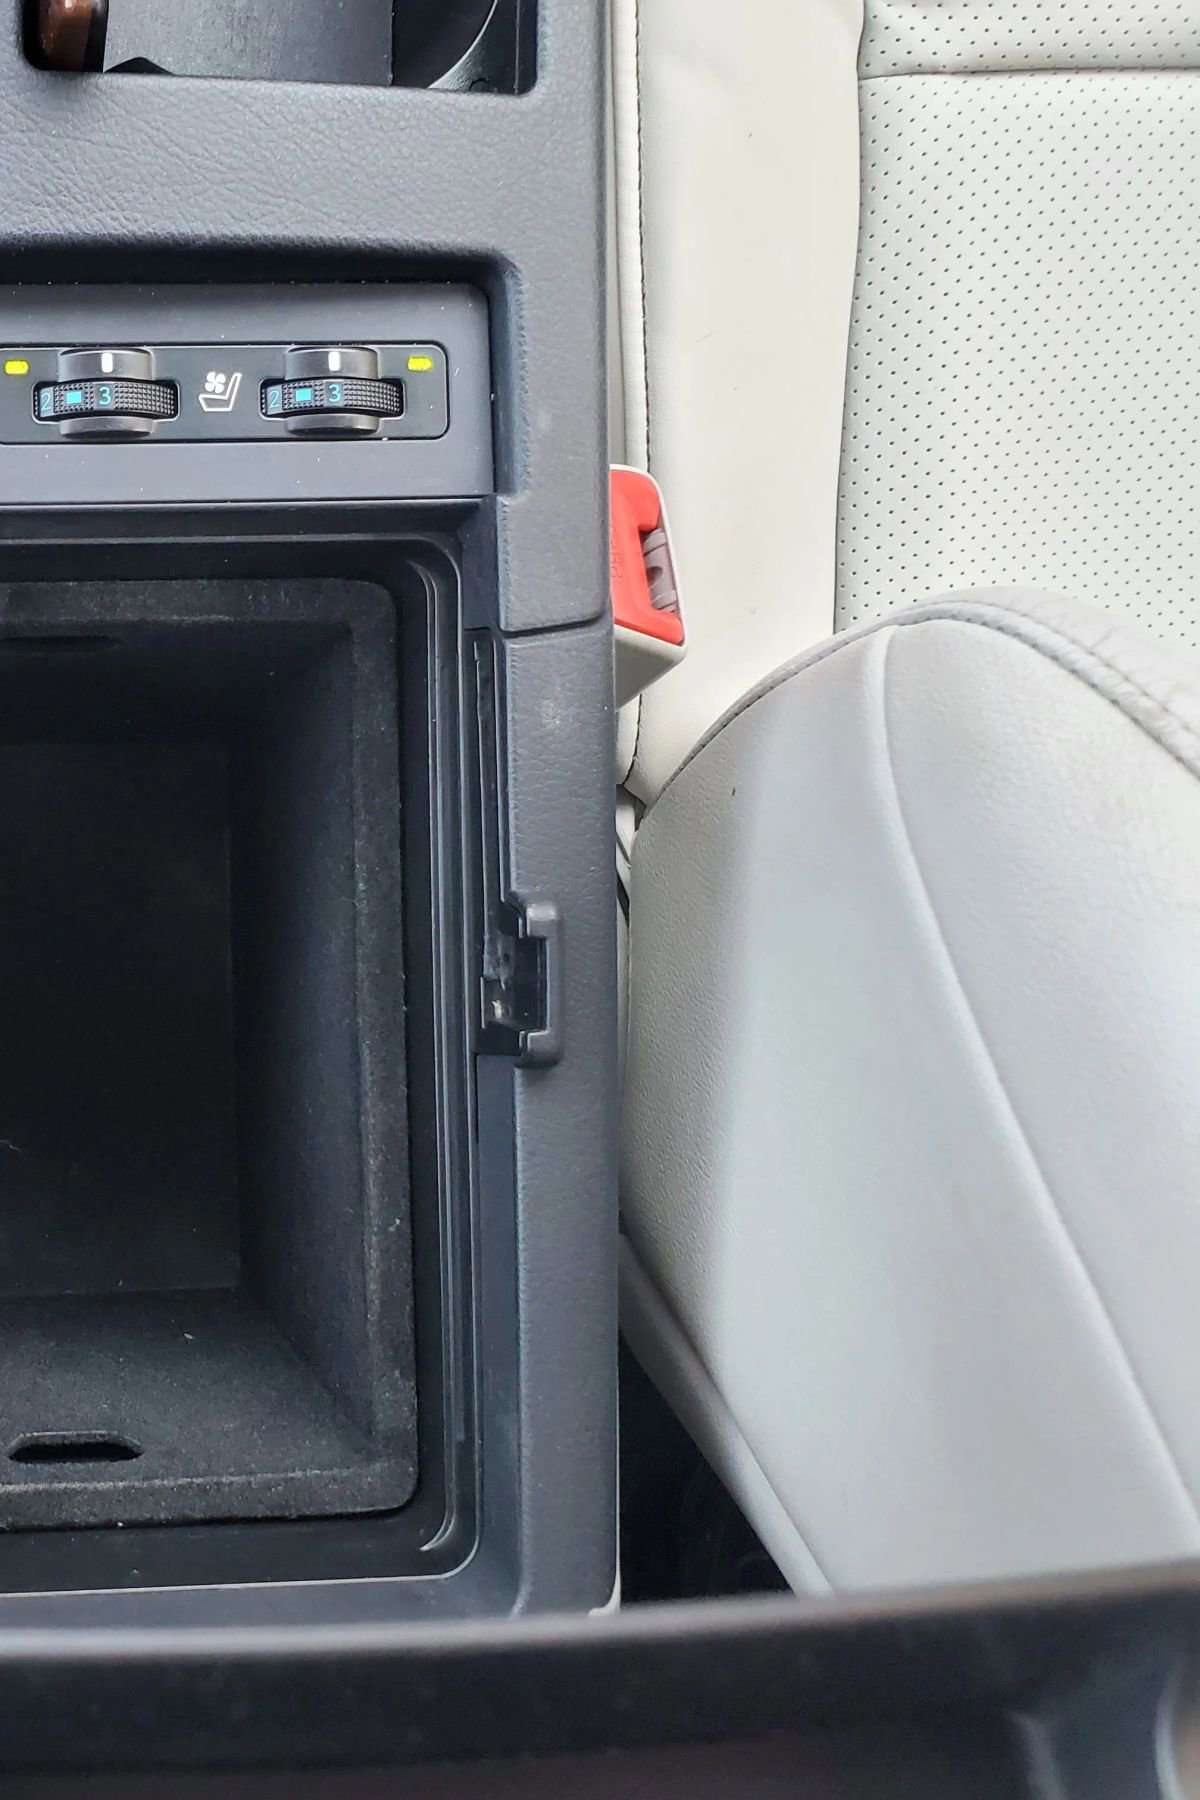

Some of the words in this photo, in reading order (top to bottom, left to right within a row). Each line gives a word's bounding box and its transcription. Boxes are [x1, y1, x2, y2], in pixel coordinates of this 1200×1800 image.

[40, 392, 51, 412] 2
[99, 386, 111, 405] 3
[268, 390, 280, 409] 2
[328, 384, 341, 403] 3
